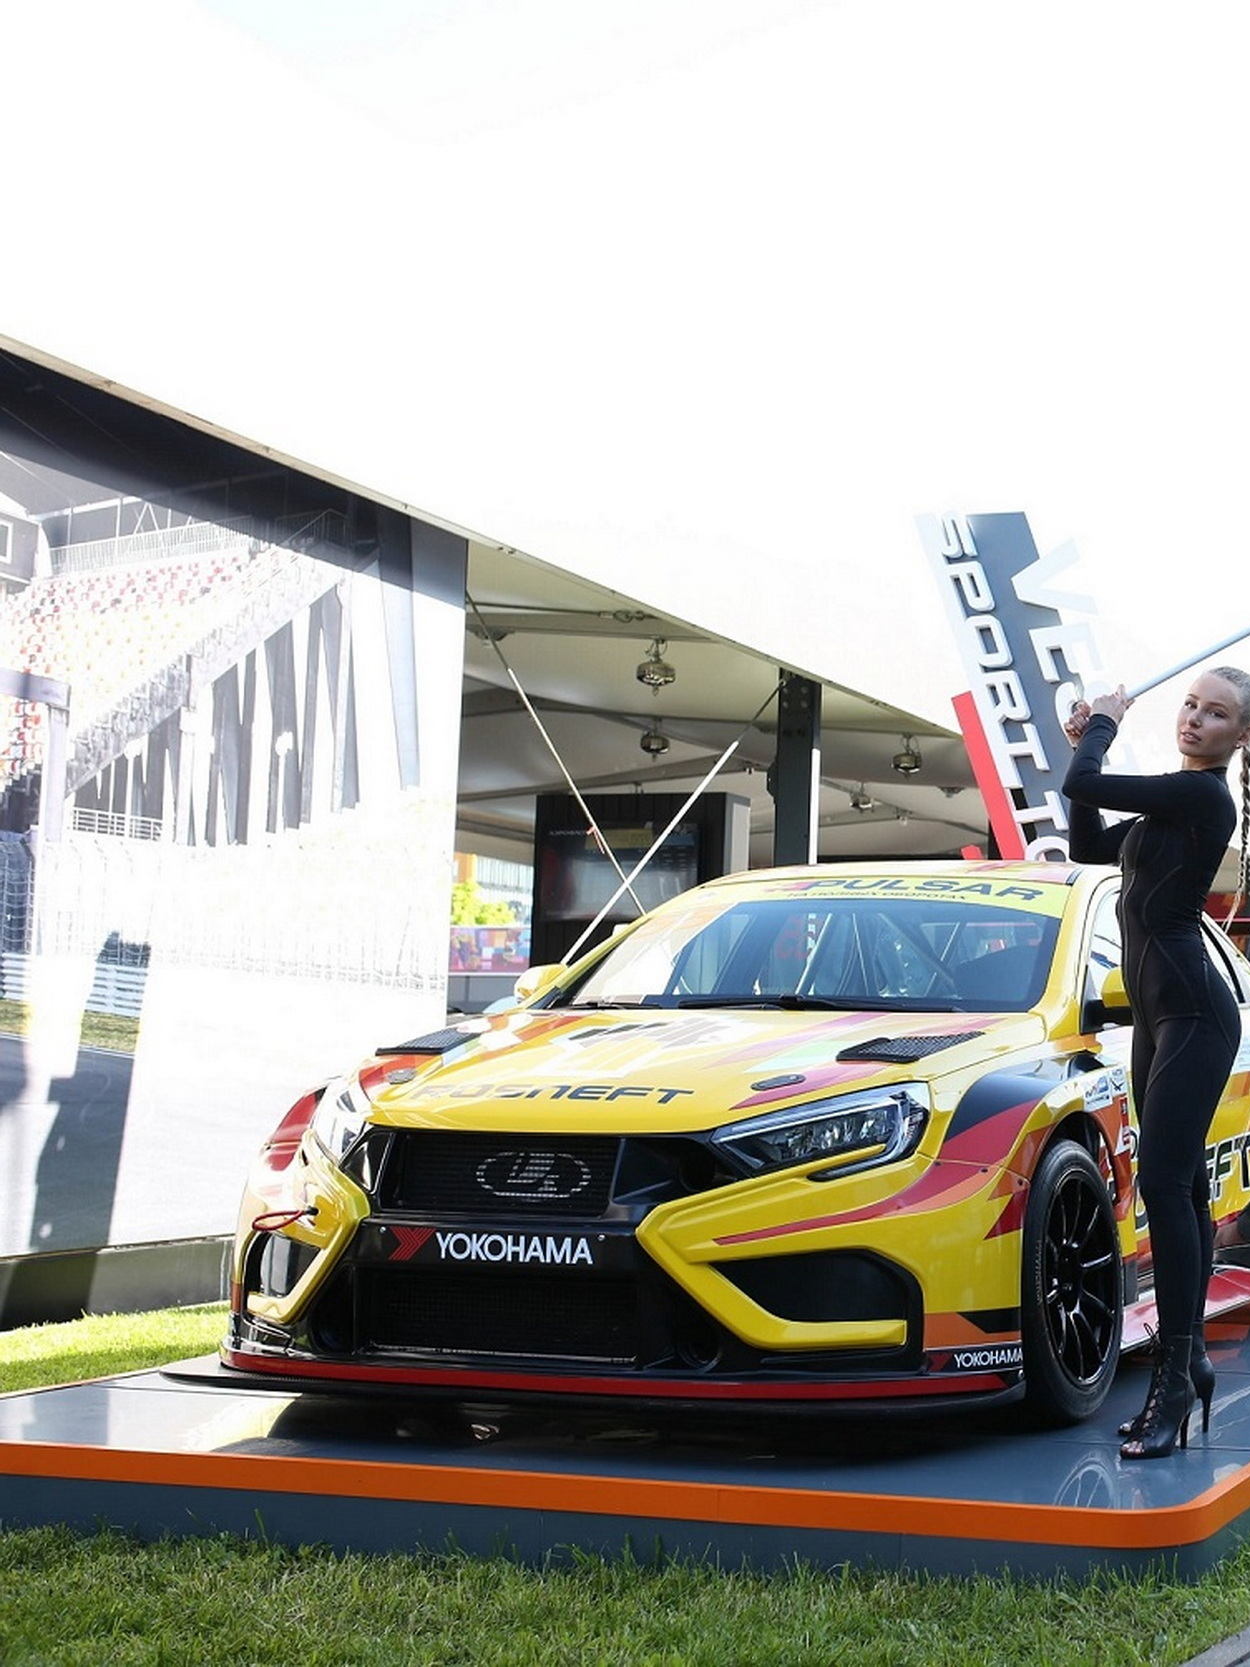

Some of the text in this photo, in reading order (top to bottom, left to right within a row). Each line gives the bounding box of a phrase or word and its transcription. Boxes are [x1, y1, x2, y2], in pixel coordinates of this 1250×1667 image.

[939, 511, 1050, 772] SPORT
[801, 879, 1044, 901] PULSAR
[410, 1083, 695, 1105] ROSNEFT
[435, 1232, 594, 1265] YOKOHAMA
[953, 1347, 1024, 1368] YOKOHAMA
